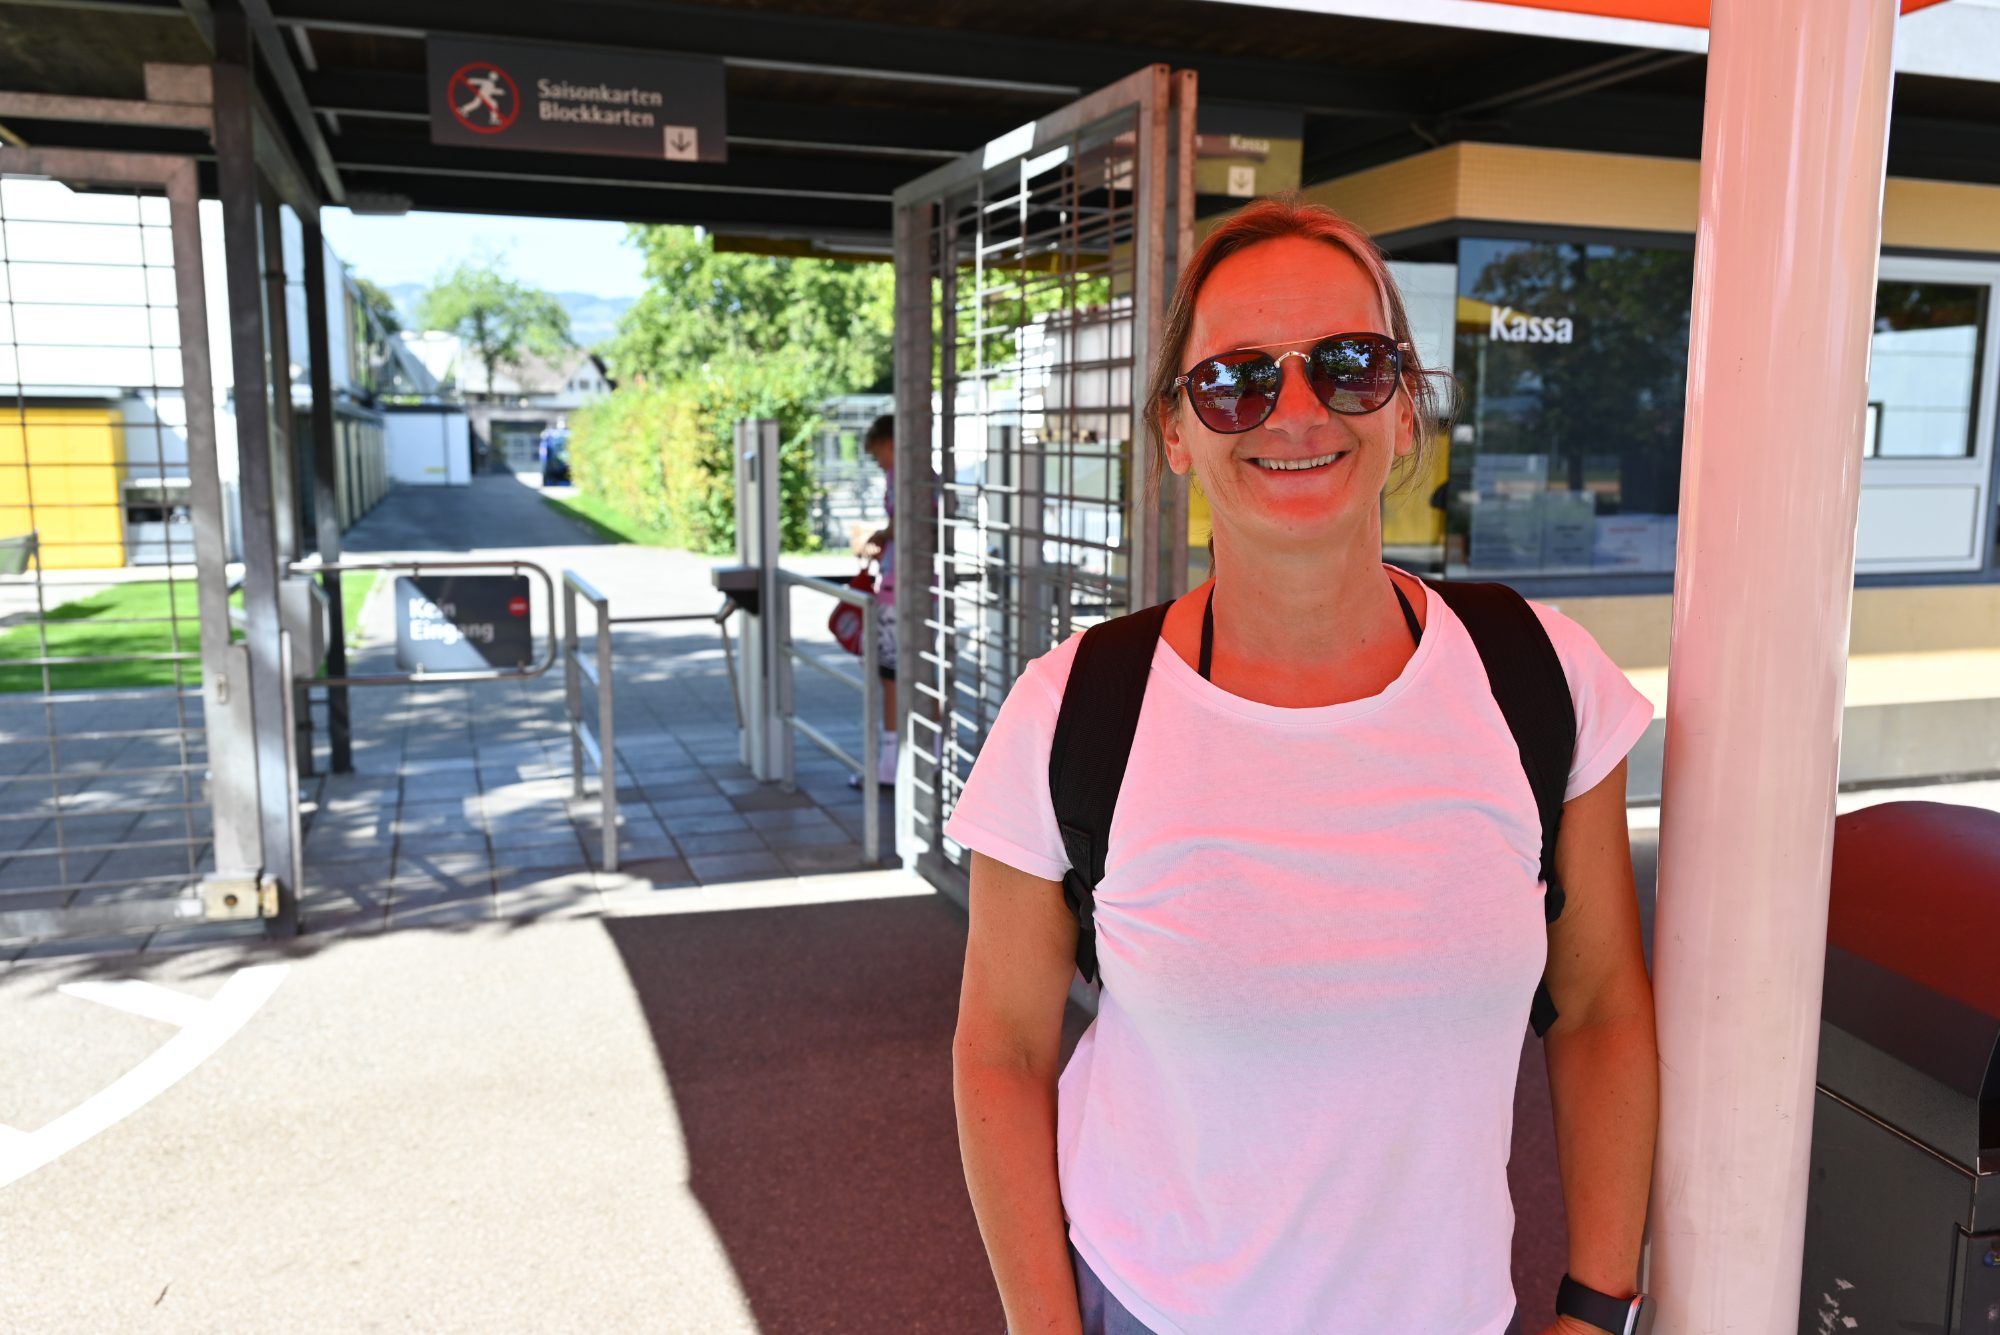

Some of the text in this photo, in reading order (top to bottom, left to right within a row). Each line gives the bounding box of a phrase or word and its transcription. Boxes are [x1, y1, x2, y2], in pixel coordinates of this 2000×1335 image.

[537, 78, 663, 107] Saisonkarten
[539, 100, 655, 127] Blockkarten
[1229, 134, 1270, 153] Kassa
[1489, 306, 1574, 344] Kassa
